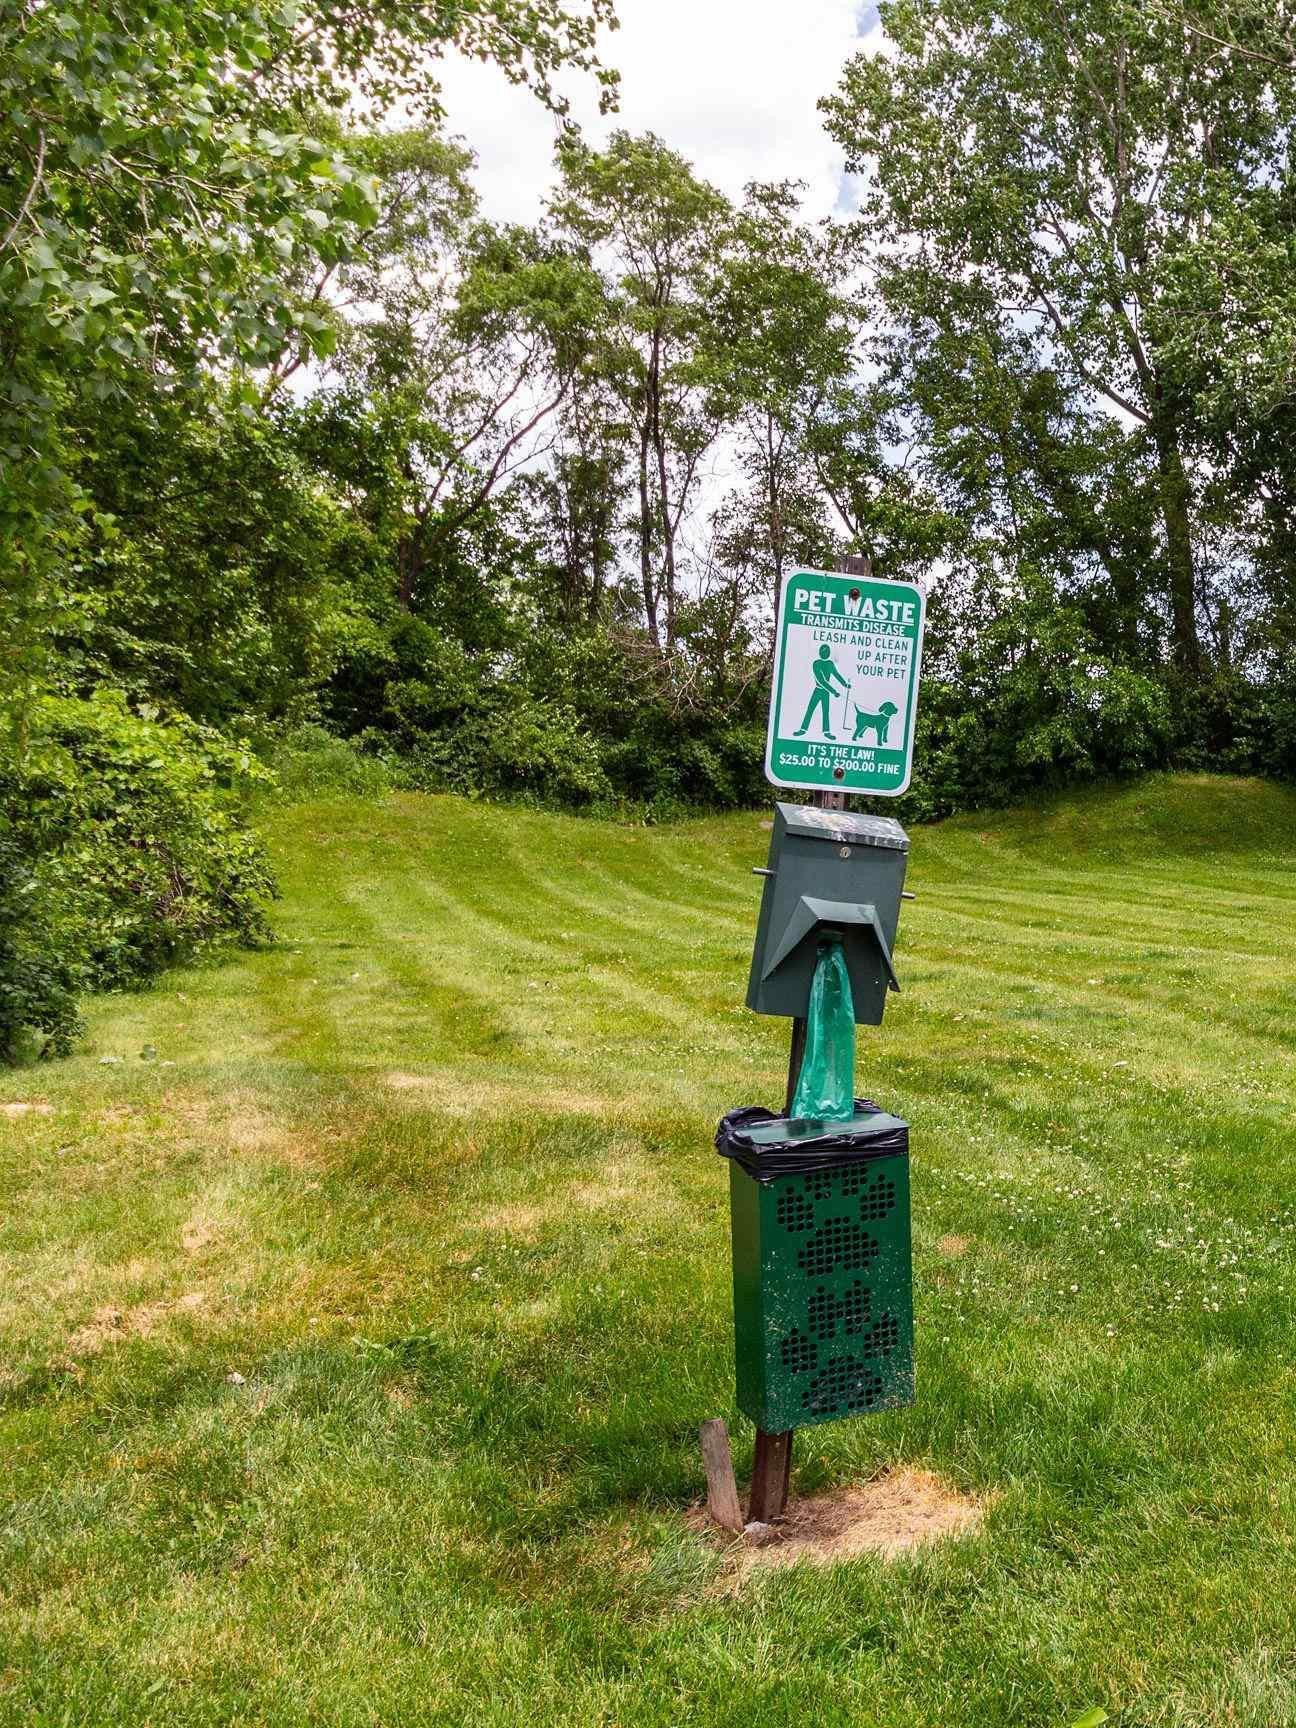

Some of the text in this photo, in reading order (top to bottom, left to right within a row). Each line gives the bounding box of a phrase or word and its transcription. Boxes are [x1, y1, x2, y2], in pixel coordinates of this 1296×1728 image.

[794, 588, 916, 624] PET WASTE
[801, 614, 905, 637] TRANSMITS DISEASE
[814, 630, 908, 650] LEASH AND CLEAN
[858, 650, 908, 666] UP AFTER
[856, 664, 906, 680] YOUR PET
[808, 744, 875, 760] IT'S THE LAW!
[780, 753, 900, 775] $25.00 TO $200.00 FINE
